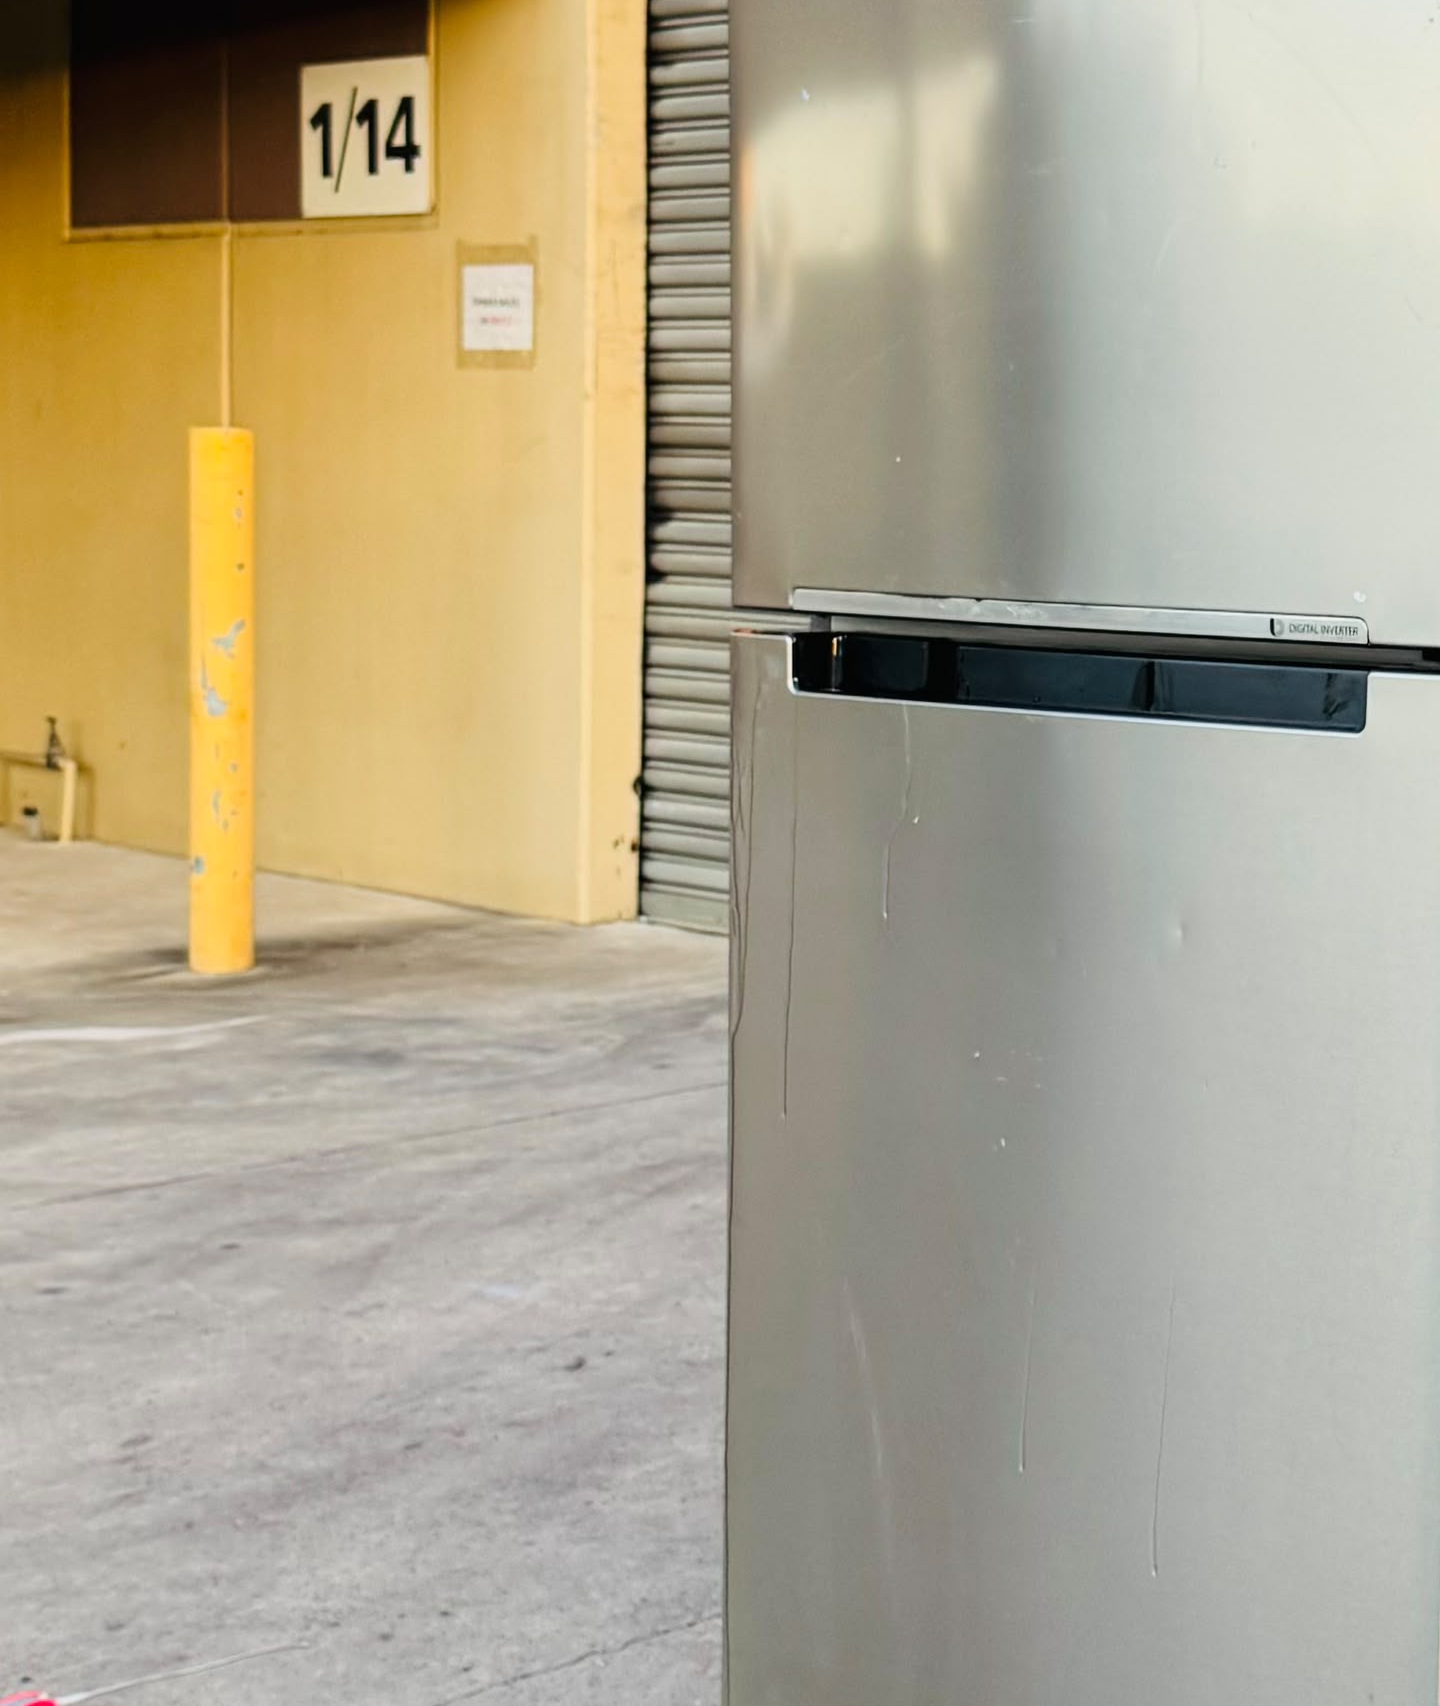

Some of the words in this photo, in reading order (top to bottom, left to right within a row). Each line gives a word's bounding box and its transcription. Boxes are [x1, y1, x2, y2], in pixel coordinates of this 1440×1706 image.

[309, 87, 421, 193] 1/14
[1289, 623, 1319, 635] DIGITAL
[1321, 625, 1359, 636] INVERTER
